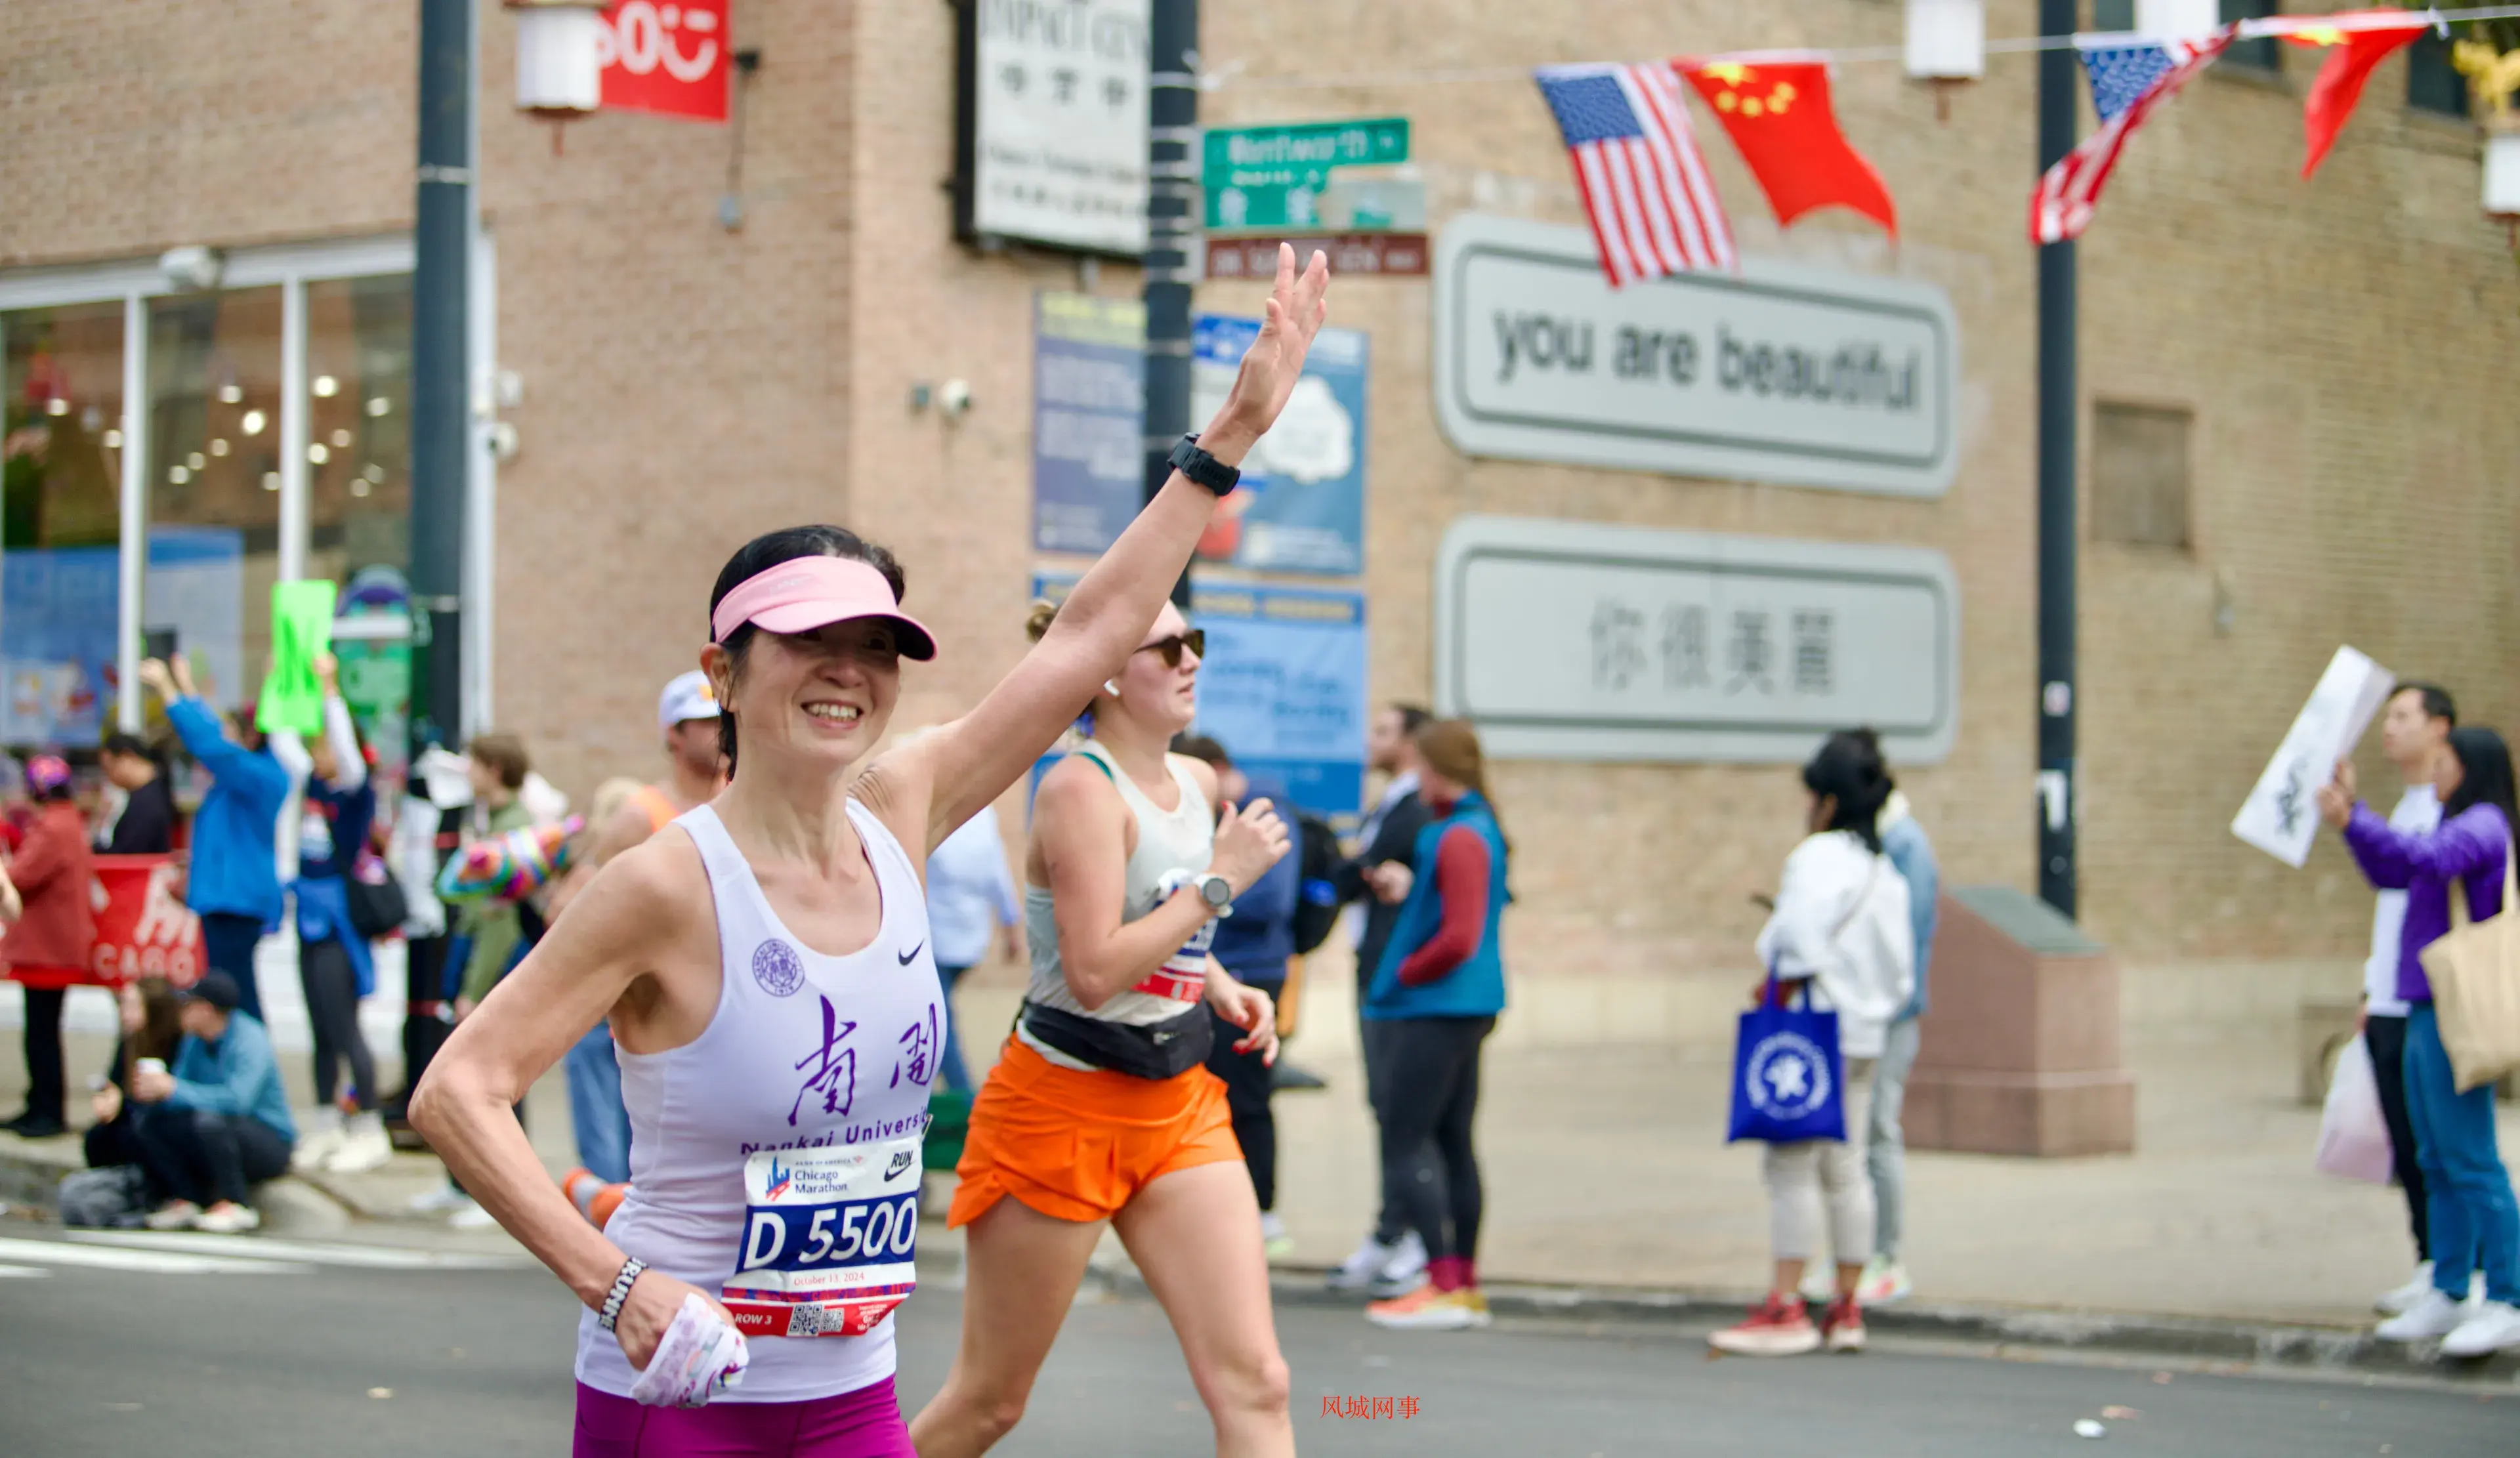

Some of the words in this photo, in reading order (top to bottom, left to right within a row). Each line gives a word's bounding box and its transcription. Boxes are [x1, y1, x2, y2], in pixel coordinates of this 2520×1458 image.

[1492, 310, 1593, 383] you
[1614, 324, 1698, 385] are
[1716, 323, 1920, 411] beautiful
[845, 1106, 927, 1144] Universit
[891, 1150, 914, 1168] RUN
[795, 1170, 839, 1182] Chicago
[795, 1182, 848, 1194] Marathon
[744, 1212, 786, 1270] D
[798, 1196, 917, 1264] 5500
[794, 1275, 826, 1287] October
[843, 1272, 865, 1282] 2024
[734, 1313, 763, 1325] ROW
[764, 1315, 773, 1325] 3
